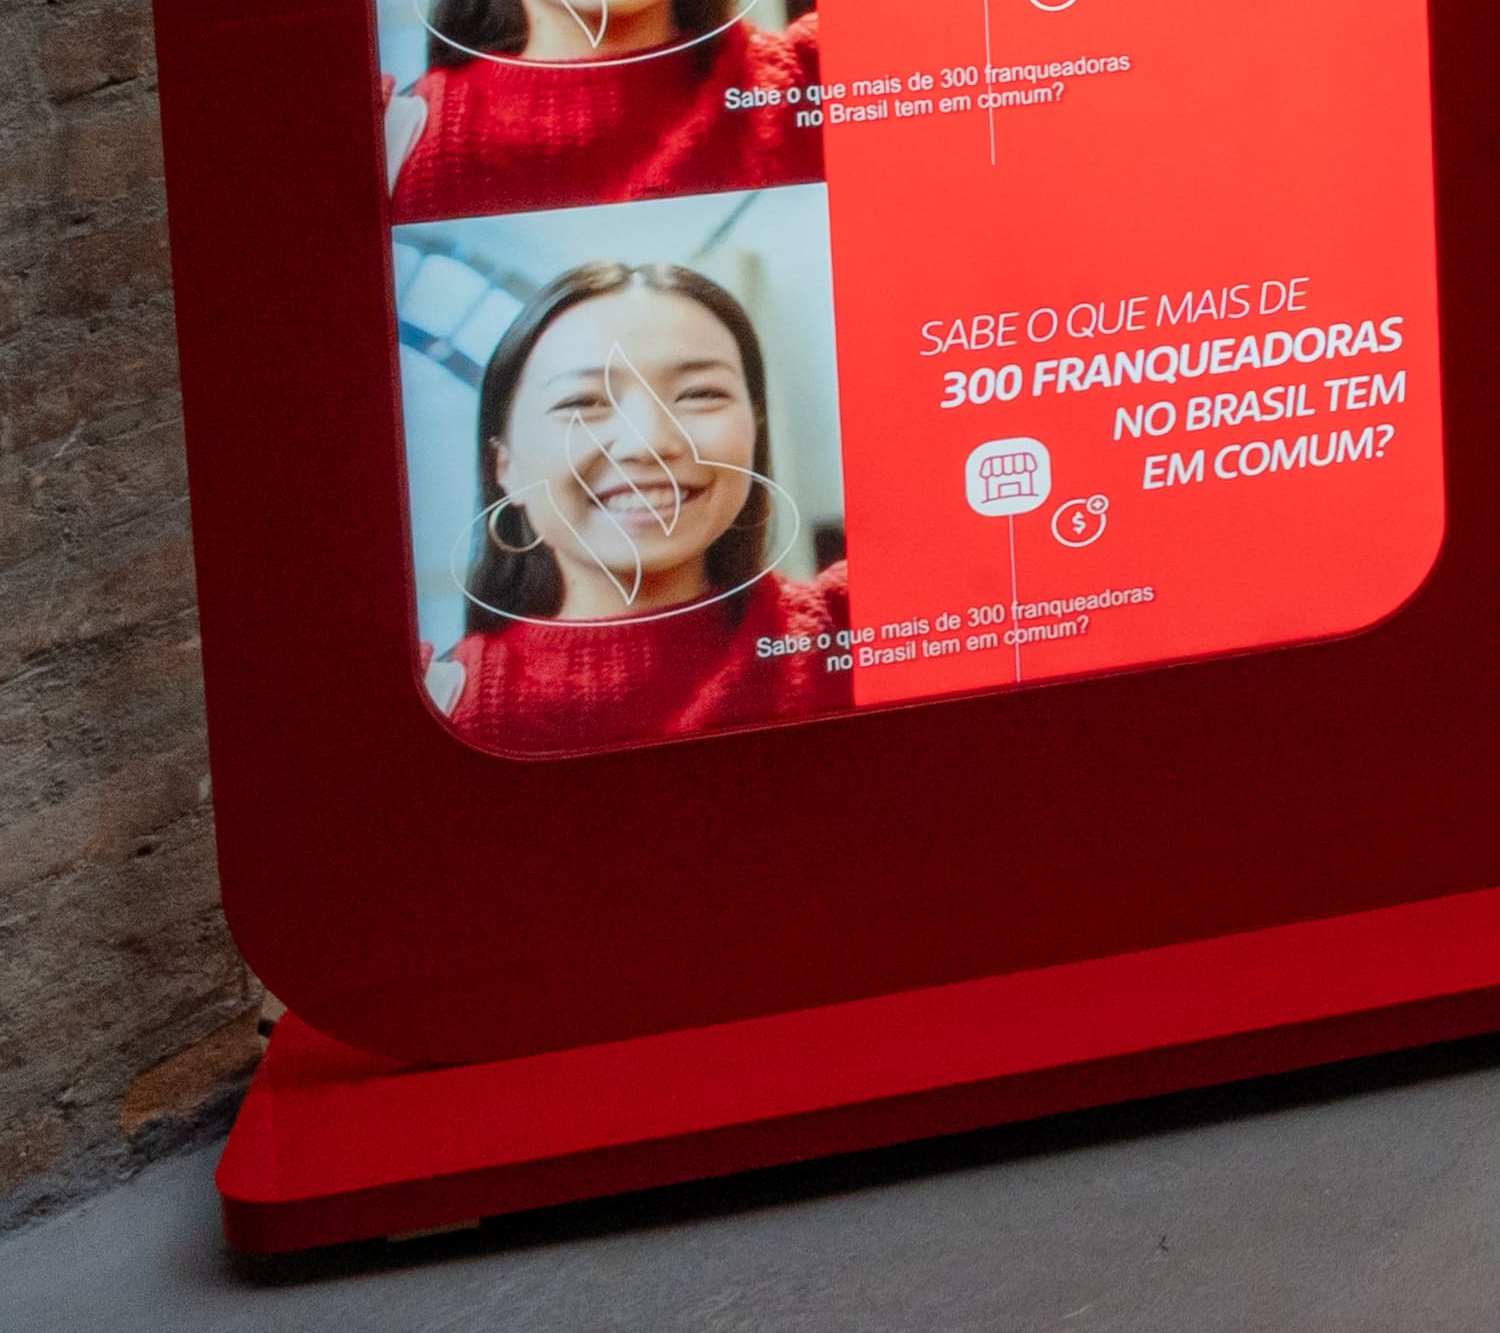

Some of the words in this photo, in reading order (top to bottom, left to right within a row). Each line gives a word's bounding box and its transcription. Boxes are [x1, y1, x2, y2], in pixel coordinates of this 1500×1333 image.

[724, 85, 782, 111] Sabe
[786, 89, 802, 106] o
[805, 83, 847, 111] que
[852, 74, 903, 98] mais
[907, 70, 935, 94] de
[939, 66, 979, 91] 300
[983, 54, 1131, 86] franqueadoras
[794, 108, 824, 129] no
[829, 100, 889, 125] Brasil
[893, 97, 934, 120] tem
[938, 95, 972, 116] em
[977, 81, 1065, 110] comum?
[918, 311, 1020, 358] SABE
[1026, 307, 1059, 344] O
[1065, 295, 1150, 341] QUE
[1155, 283, 1251, 328] MAIS
[1257, 276, 1311, 316] DE
[939, 363, 1024, 411] 300
[1031, 315, 1405, 399] FRANQUEADORAS
[1112, 400, 1177, 442] NO
[1184, 383, 1316, 433] BRASIL
[1323, 370, 1408, 414] TEM
[1141, 449, 1206, 492] EM
[1213, 423, 1396, 481] COMUM?
[755, 633, 812, 660] Sabe
[816, 634, 833, 652] o
[835, 627, 876, 655] que
[880, 617, 931, 642] mais
[935, 611, 962, 635] de
[966, 604, 1006, 630] 300
[1010, 584, 1156, 624] franqueadoras
[825, 652, 854, 674] no
[858, 640, 917, 669] Brasil
[921, 634, 962, 659] tem
[965, 631, 999, 653] em
[1002, 614, 1091, 646] comum?
